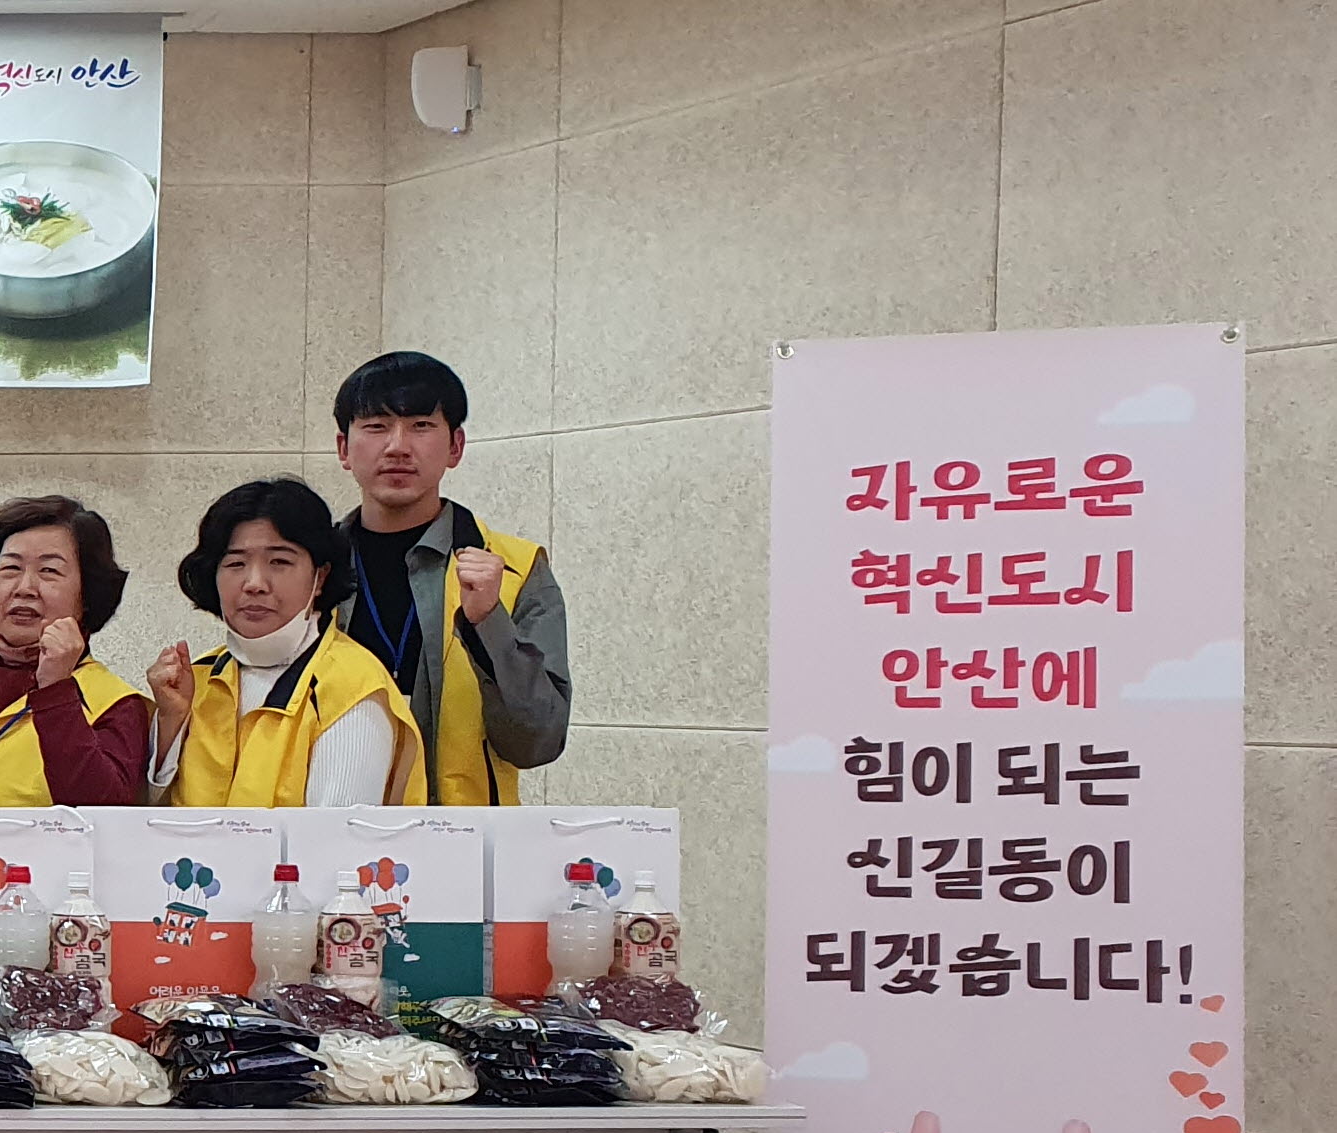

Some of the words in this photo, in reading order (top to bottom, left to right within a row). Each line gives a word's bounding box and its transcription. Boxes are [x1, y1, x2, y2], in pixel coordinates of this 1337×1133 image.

[71, 58, 139, 88] 안산
[845, 453, 1144, 521] 자유로운
[851, 549, 1134, 614] 혁신도시
[881, 647, 1098, 709] 안산에
[844, 736, 971, 804] 힘이
[997, 742, 1141, 806] 되는
[847, 836, 1131, 904] 신길동이
[75, 953, 105, 969] 곰국
[349, 951, 378, 967] 곰국
[649, 951, 677, 967] 곰국
[805, 930, 1194, 1005] 되겠습니다!
